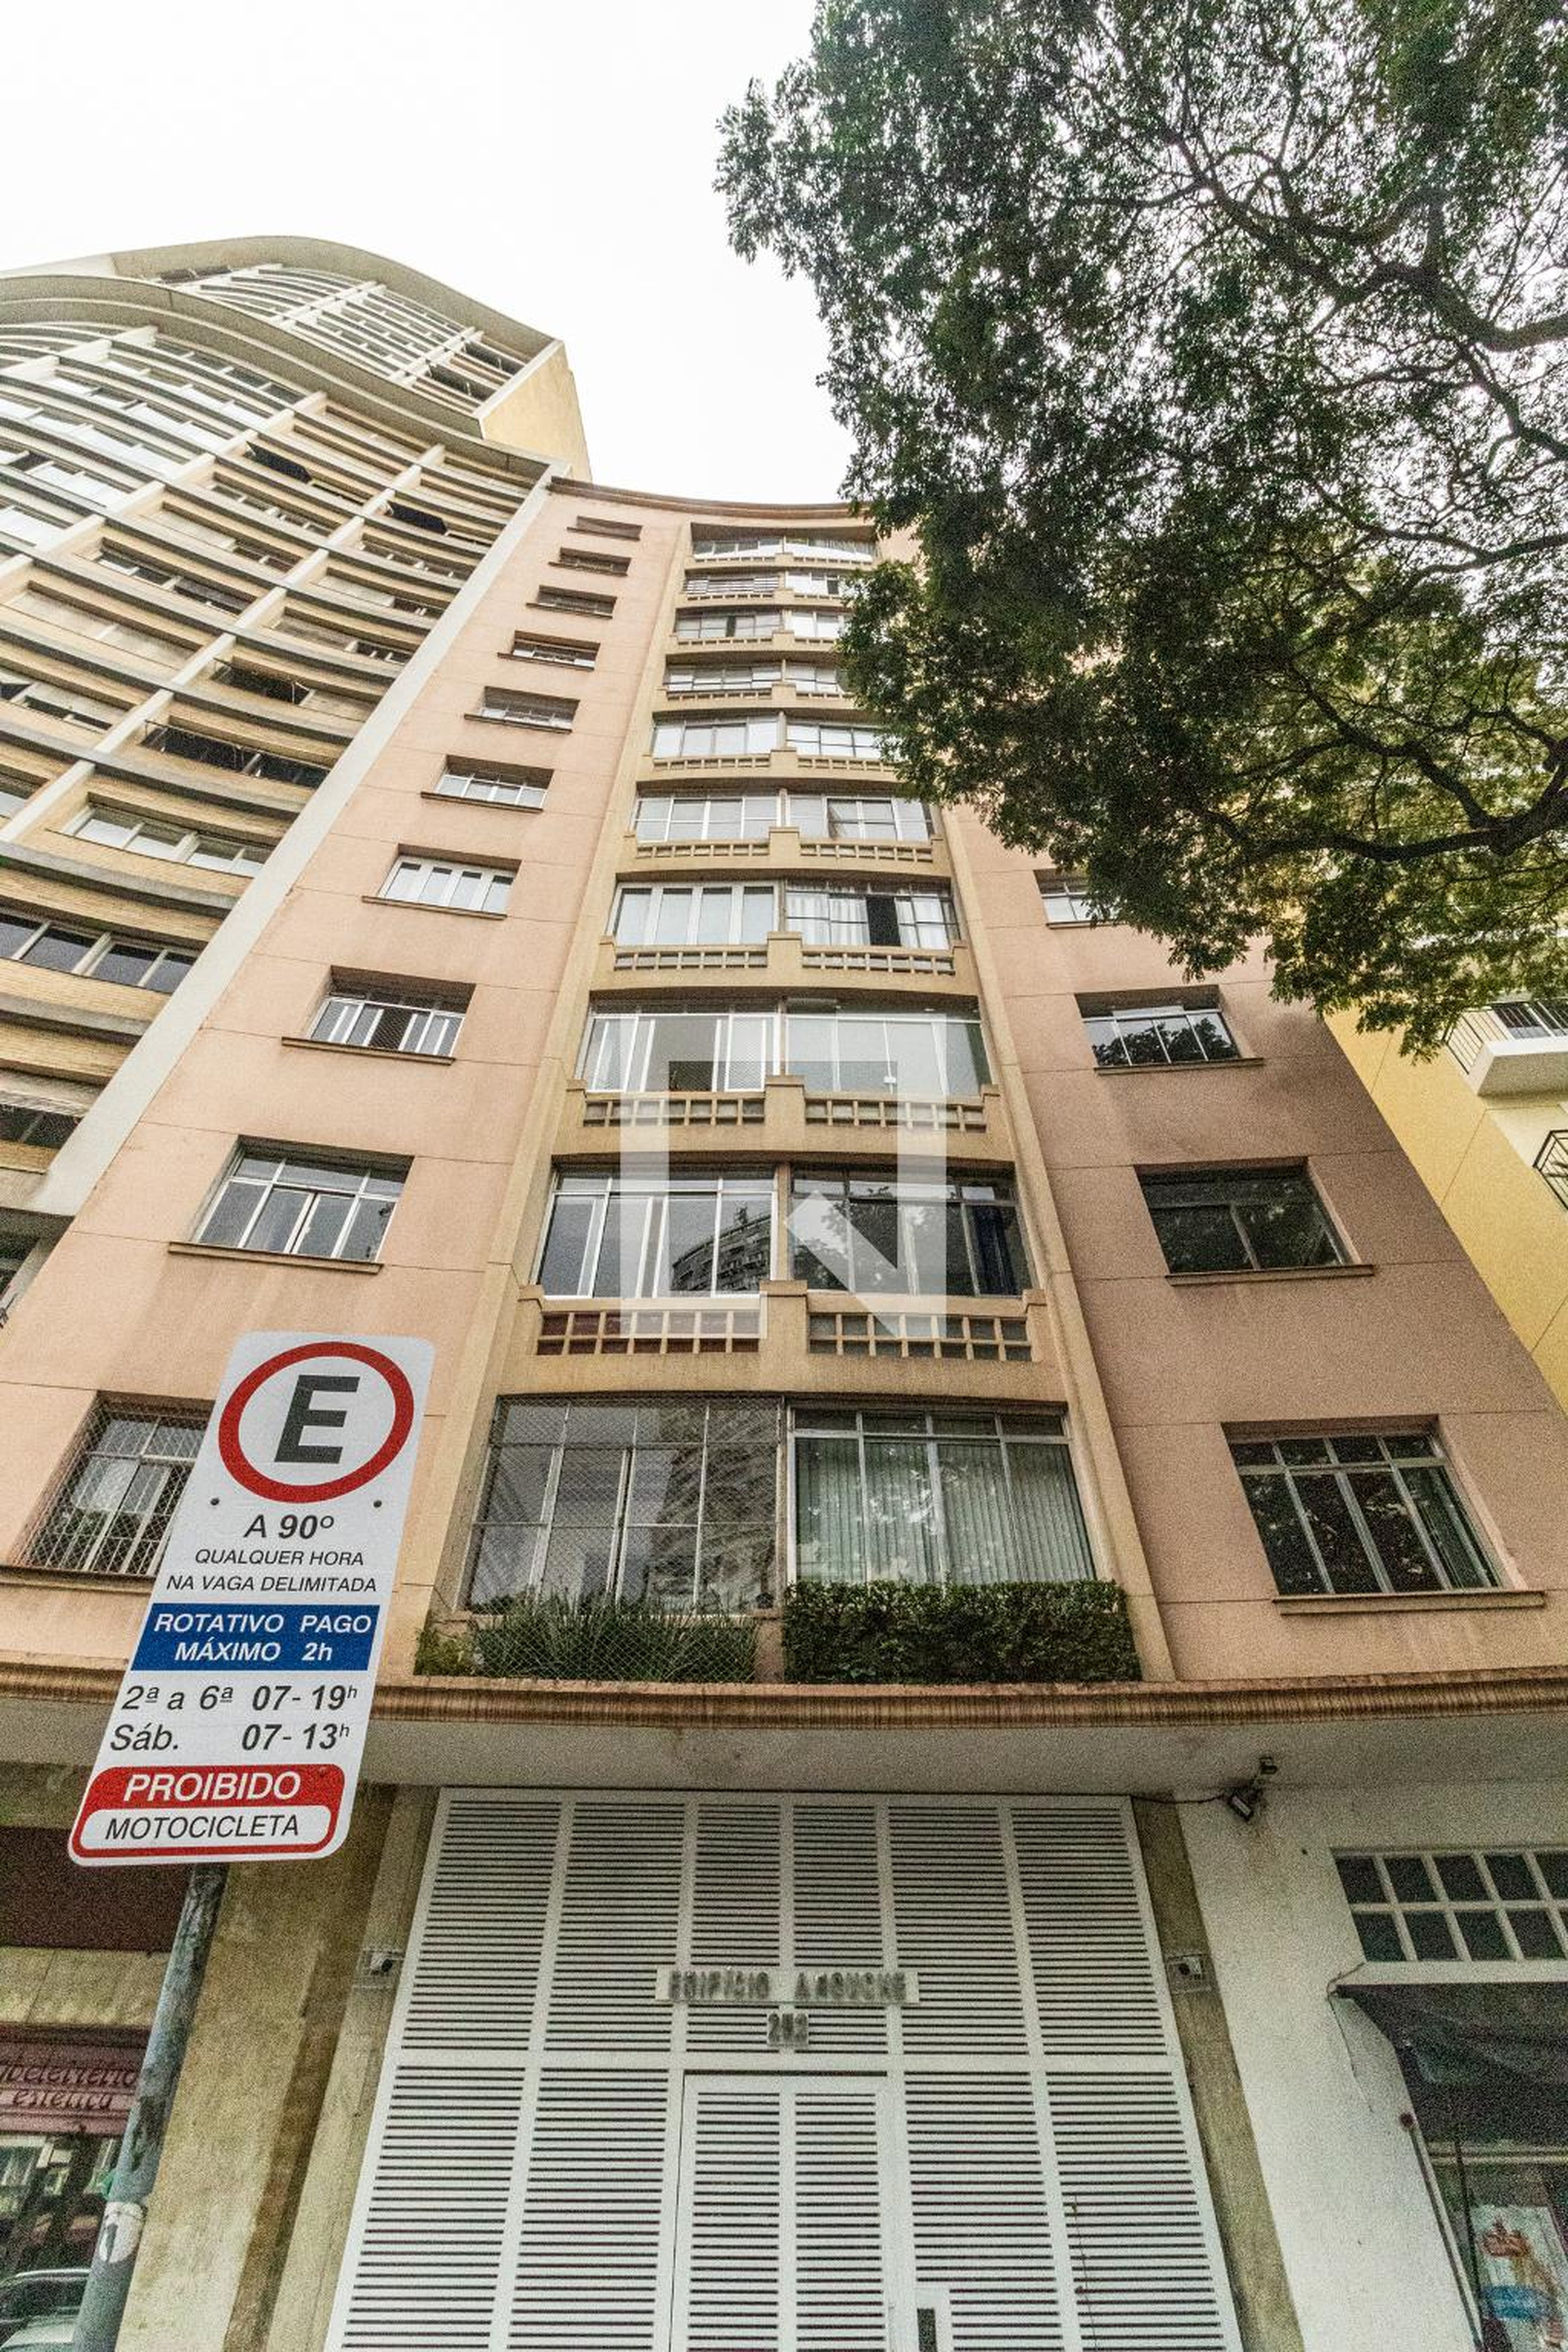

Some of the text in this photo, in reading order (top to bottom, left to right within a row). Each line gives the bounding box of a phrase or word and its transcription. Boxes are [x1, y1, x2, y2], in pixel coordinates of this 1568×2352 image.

[274, 1374, 360, 1464] E
[244, 1514, 267, 1538] A
[195, 1549, 364, 1567] QUALQUER HORA
[167, 1576, 377, 1592] NA VAGA DELIMITADA
[154, 1614, 372, 1634] ROTATIVO PAGO
[174, 1637, 333, 1661] MÁXIMO 2h
[167, 1692, 185, 1710] a
[110, 1724, 180, 1751] Sáb.
[123, 1771, 301, 1802] PROIBIDO
[105, 1815, 299, 1840] MOTOCICLETA
